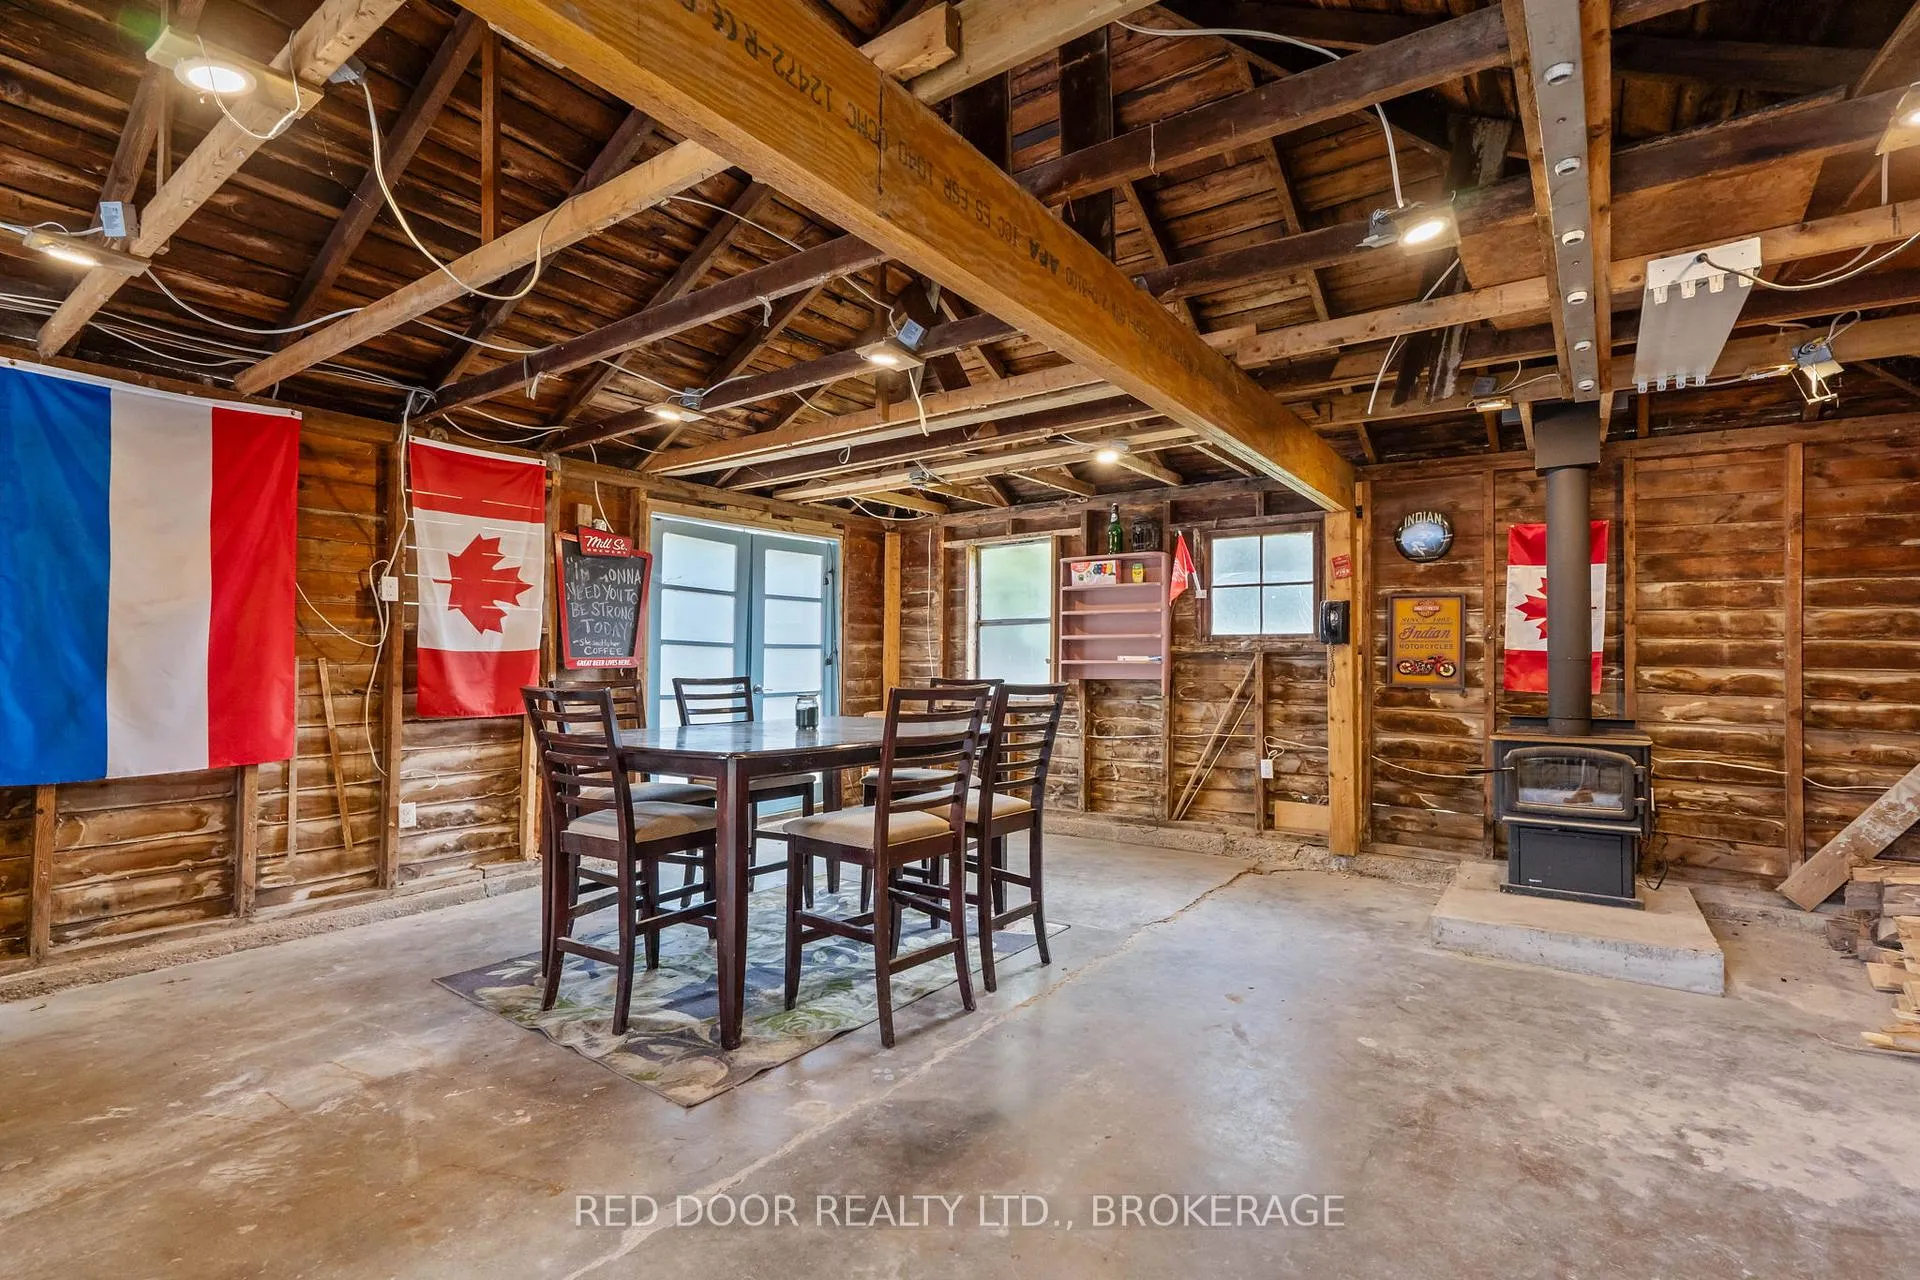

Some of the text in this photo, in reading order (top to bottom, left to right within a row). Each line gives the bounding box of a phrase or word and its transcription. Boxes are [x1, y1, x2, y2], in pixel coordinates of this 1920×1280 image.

[743, 20, 833, 113] 12472-R
[943, 177, 969, 213] ESR
[975, 198, 992, 230] ES
[1404, 511, 1442, 529] INDIAN
[584, 535, 628, 551] Mill St.
[566, 582, 639, 605] NEED YOU TO
[571, 602, 635, 622] BE STRONG
[1399, 625, 1451, 640] Indian
[583, 646, 624, 656] COFFEE
[576, 659, 592, 667] GREAT
